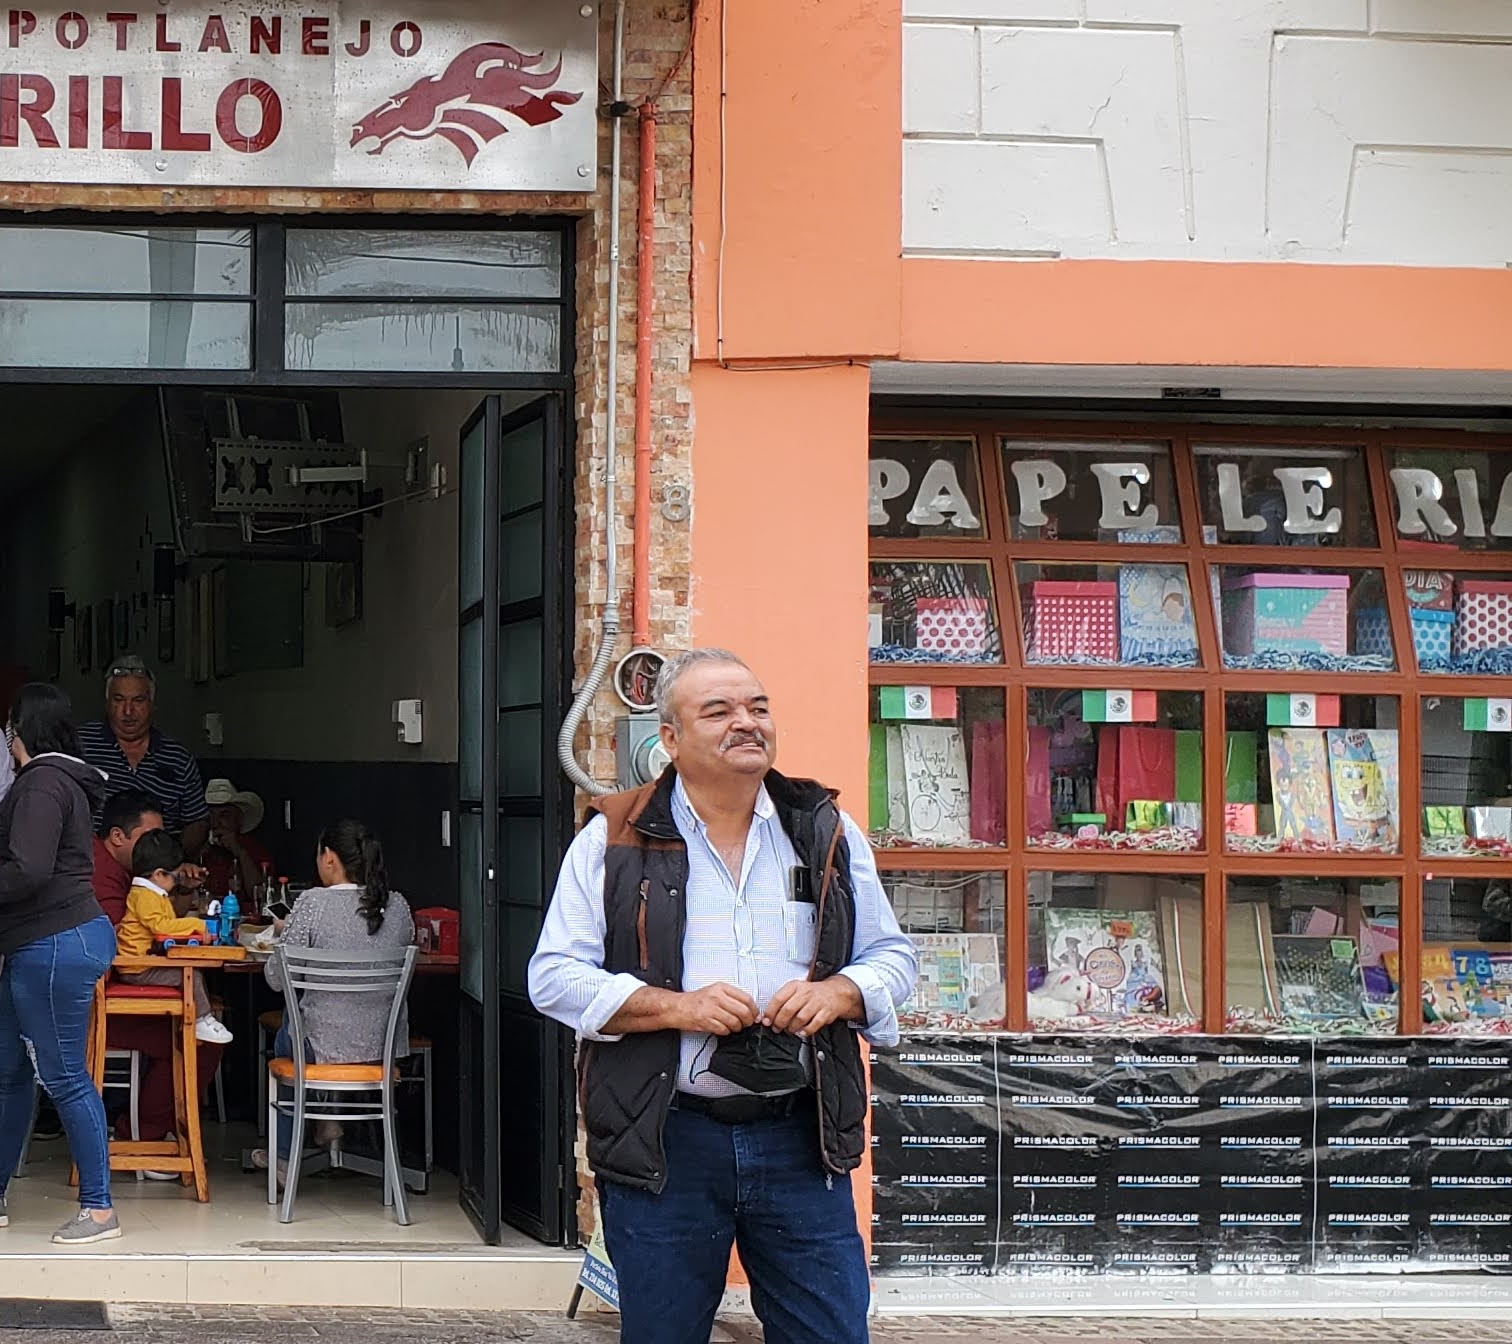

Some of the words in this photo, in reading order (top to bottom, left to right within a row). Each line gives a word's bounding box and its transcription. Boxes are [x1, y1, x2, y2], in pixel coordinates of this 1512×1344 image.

[900, 1053, 983, 1063] PRISMACOLOR
[1010, 1054, 1093, 1064] PRISMACOLOR
[1115, 1055, 1197, 1064] PRISMACOLOR
[1219, 1055, 1300, 1065] PRISMACOLOR
[1327, 1055, 1408, 1065] PRISMACOLOR
[1428, 1056, 1508, 1066] PRISMACOLOR
[900, 1094, 985, 1104] PRISMACOLOR
[1012, 1095, 1095, 1105] PRISMACOLOR
[1117, 1095, 1199, 1105] PRISMACOLOR
[1220, 1096, 1302, 1106] PRISMACOLOR
[1328, 1096, 1409, 1106] PRISMACOLOR
[1429, 1096, 1509, 1106] PRISMACOLOR
[902, 1135, 987, 1145] PRISMACOLOR
[1014, 1136, 1097, 1146] PRISMACOLOR
[1119, 1136, 1200, 1146] PRISMACOLOR
[1221, 1136, 1302, 1146] PRISMACOLOR
[1328, 1136, 1410, 1146] PRISMACOLOR
[1430, 1136, 1512, 1147] PRISMACOLOR
[901, 1174, 986, 1184] PRISMACOLOR
[1013, 1175, 1096, 1185] PRISMACOLOR
[1118, 1175, 1200, 1185] PRISMACOLOR
[1221, 1175, 1302, 1185] PRISMACOLOR
[1329, 1175, 1411, 1185] PRISMACOLOR
[1431, 1175, 1512, 1185] PRISMACOLOR
[902, 1213, 987, 1223] PRISMACOLOR
[1013, 1213, 1096, 1223] PRISMACOLOR
[1116, 1213, 1199, 1223] PRISMACOLOR
[1220, 1213, 1302, 1223] PRISMACOLOR
[1328, 1213, 1410, 1223] PRISMACOLOR
[1430, 1213, 1512, 1223] PRISMACOLOR
